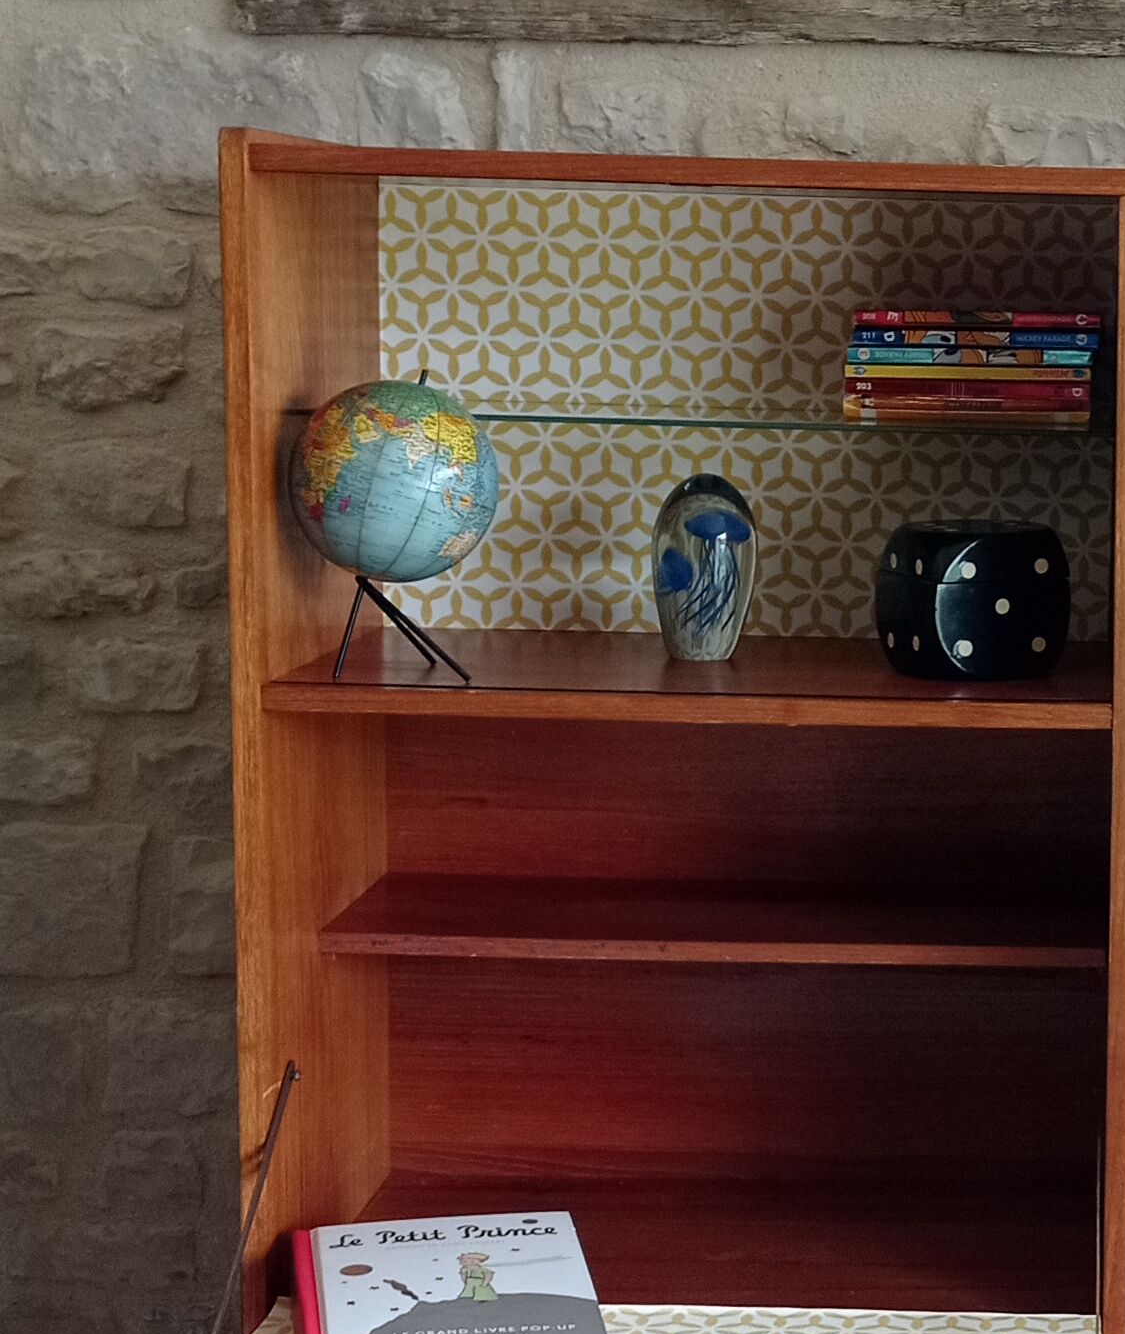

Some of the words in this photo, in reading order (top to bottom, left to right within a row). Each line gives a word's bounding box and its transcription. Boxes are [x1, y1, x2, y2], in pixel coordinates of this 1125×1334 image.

[328, 1233, 363, 1249] Le
[375, 1228, 446, 1245] Petit
[456, 1224, 558, 1240] Prince
[474, 1326, 516, 1334] LIVRE
